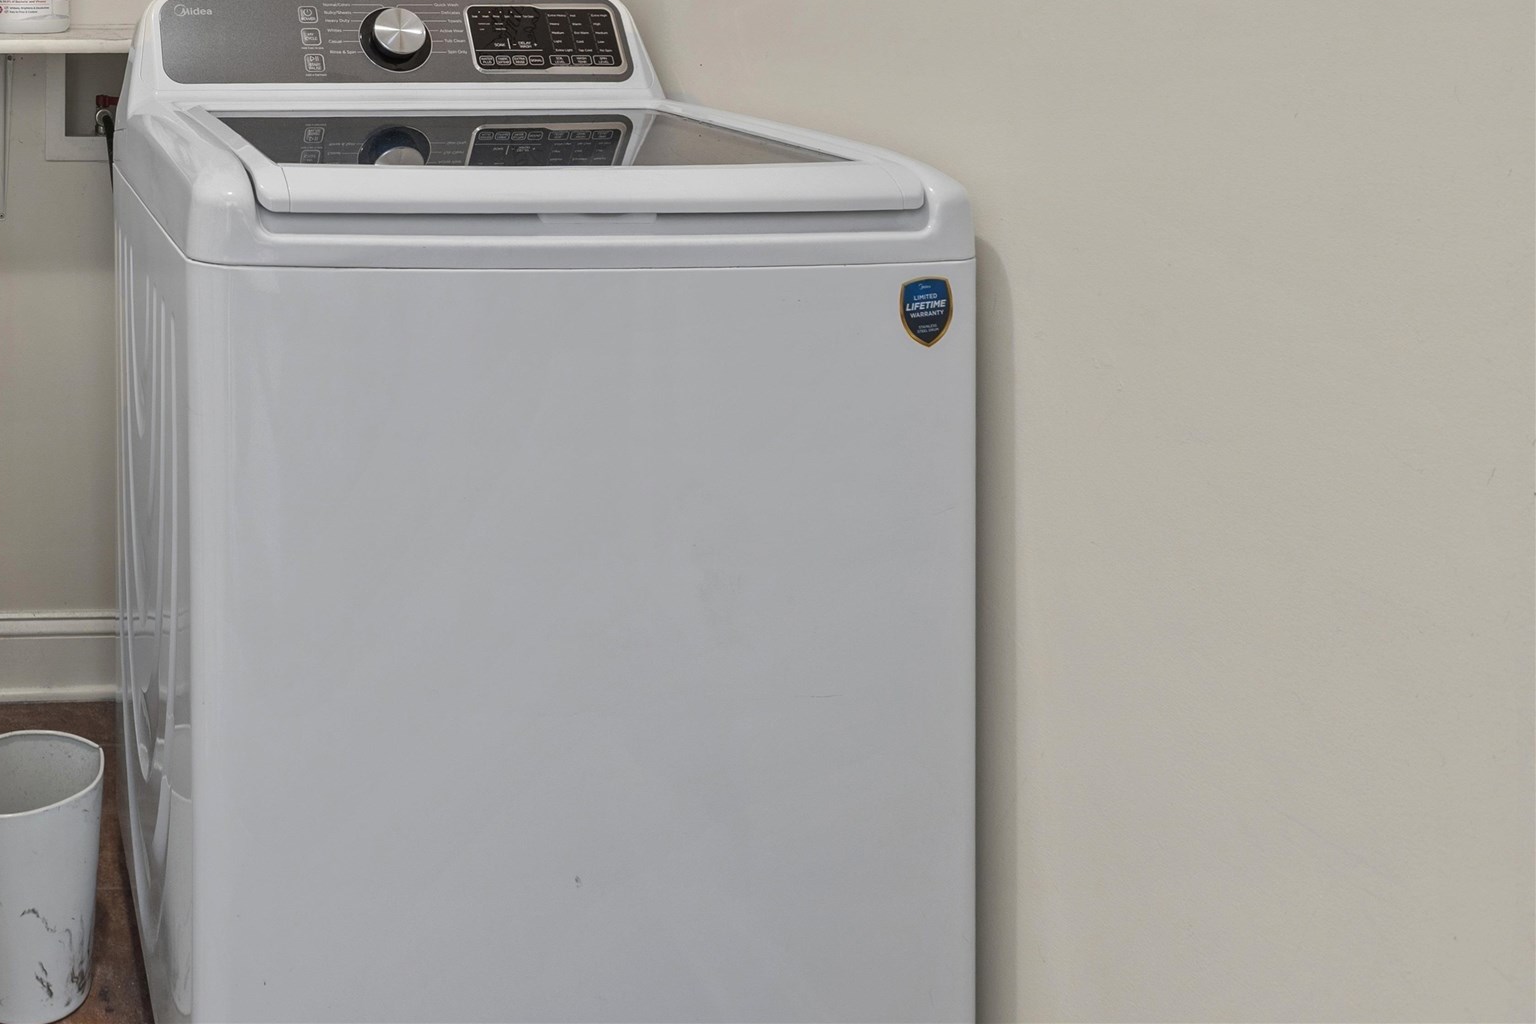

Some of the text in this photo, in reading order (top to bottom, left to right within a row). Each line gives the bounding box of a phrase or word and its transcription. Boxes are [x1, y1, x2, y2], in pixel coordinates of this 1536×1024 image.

[175, 4, 213, 17] Midea
[913, 293, 938, 301] LIMITED
[906, 299, 946, 311] LIFETIME
[910, 310, 944, 318] WARRANTY
